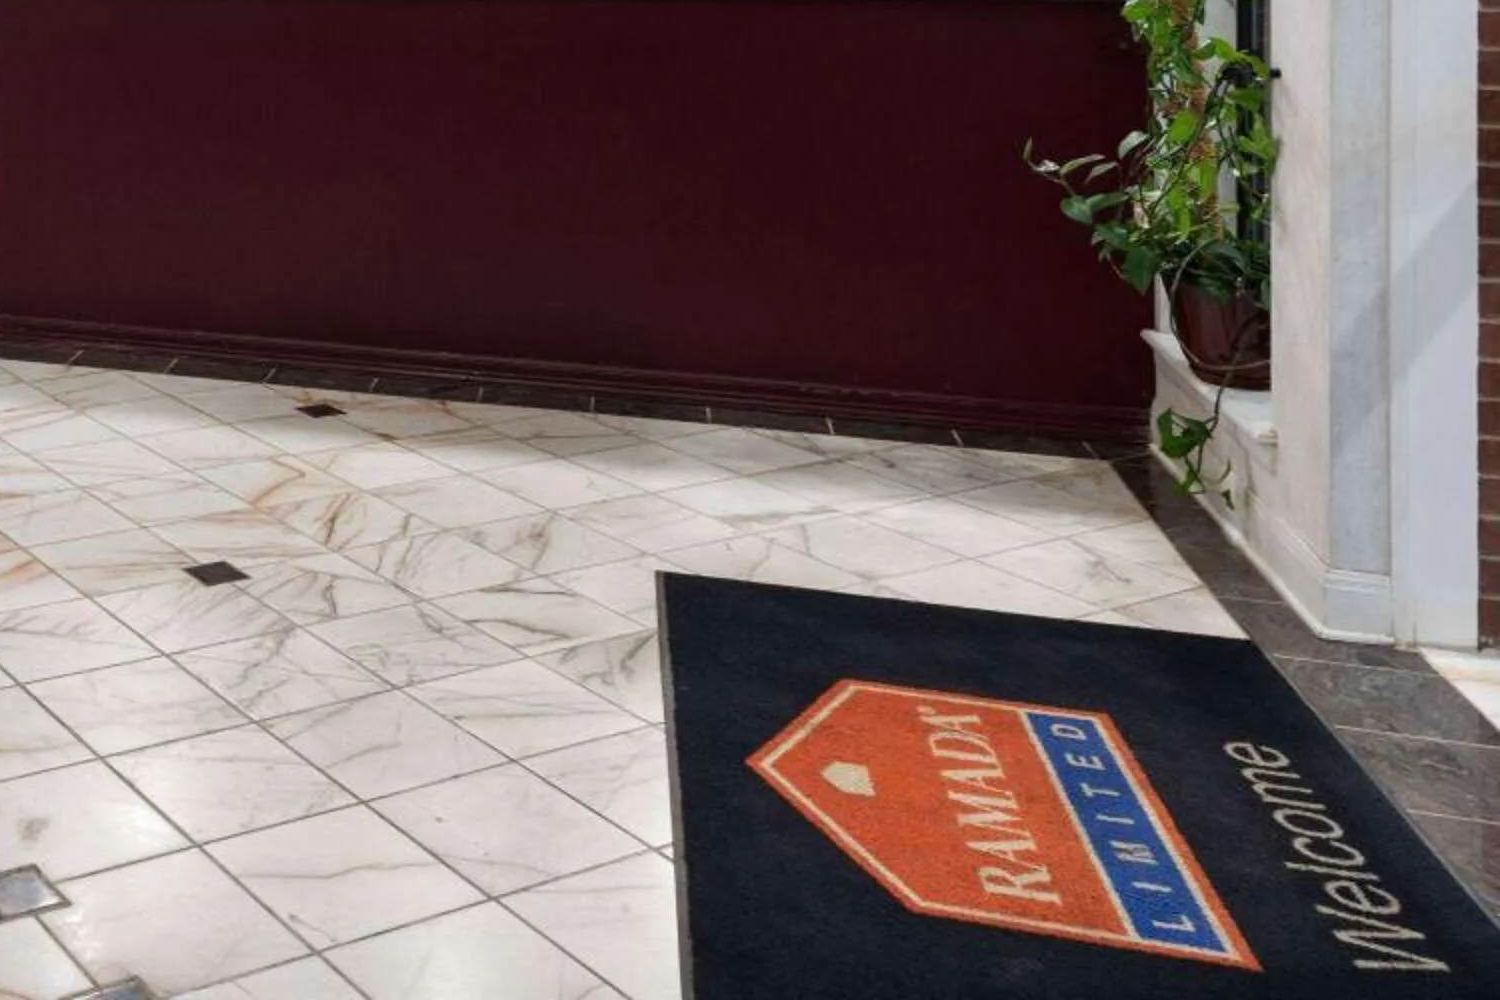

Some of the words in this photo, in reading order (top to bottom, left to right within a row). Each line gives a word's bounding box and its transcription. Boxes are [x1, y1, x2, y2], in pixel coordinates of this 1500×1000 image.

[918, 714, 1063, 906] RAMADA
[1051, 722, 1197, 933] LIMITED
[1223, 741, 1452, 973] Welcome
